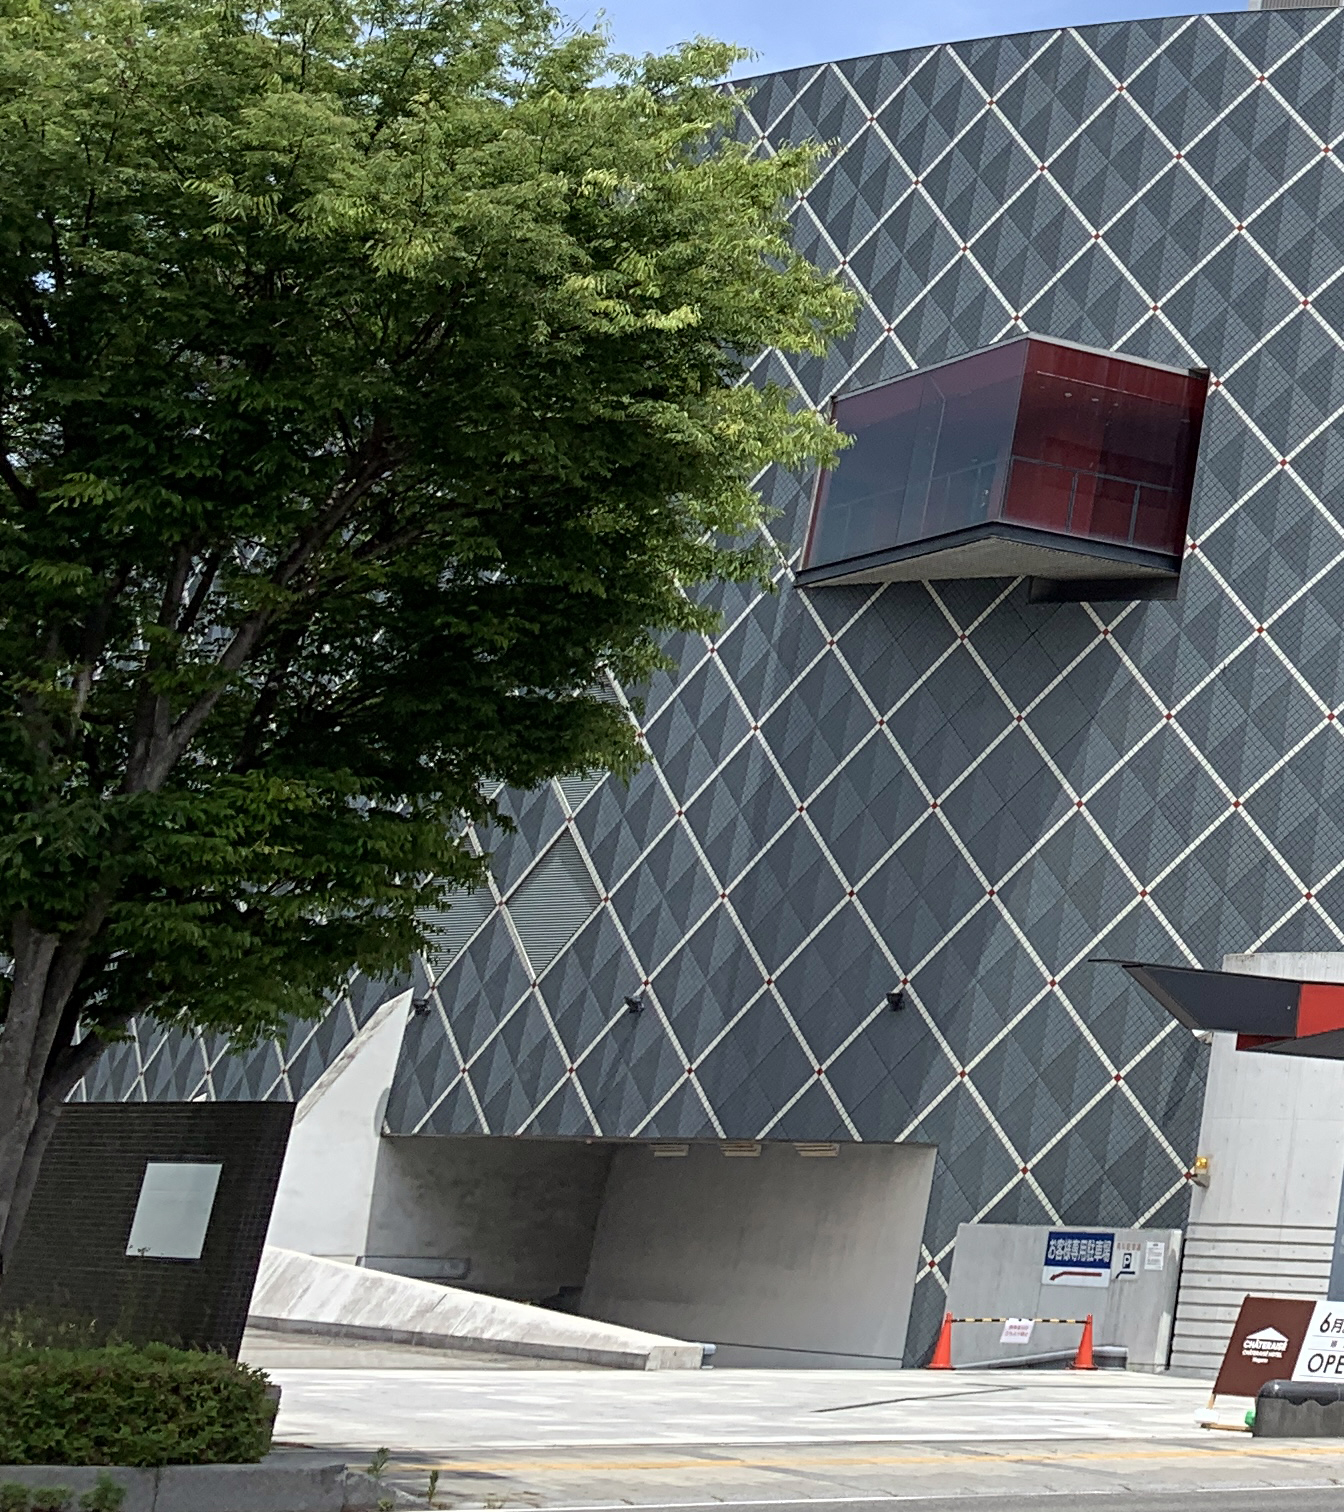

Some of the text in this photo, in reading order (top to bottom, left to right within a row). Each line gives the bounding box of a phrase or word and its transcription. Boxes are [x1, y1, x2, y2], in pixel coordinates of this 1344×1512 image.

[1048, 1239, 1111, 1262] お客様専用駐車場
